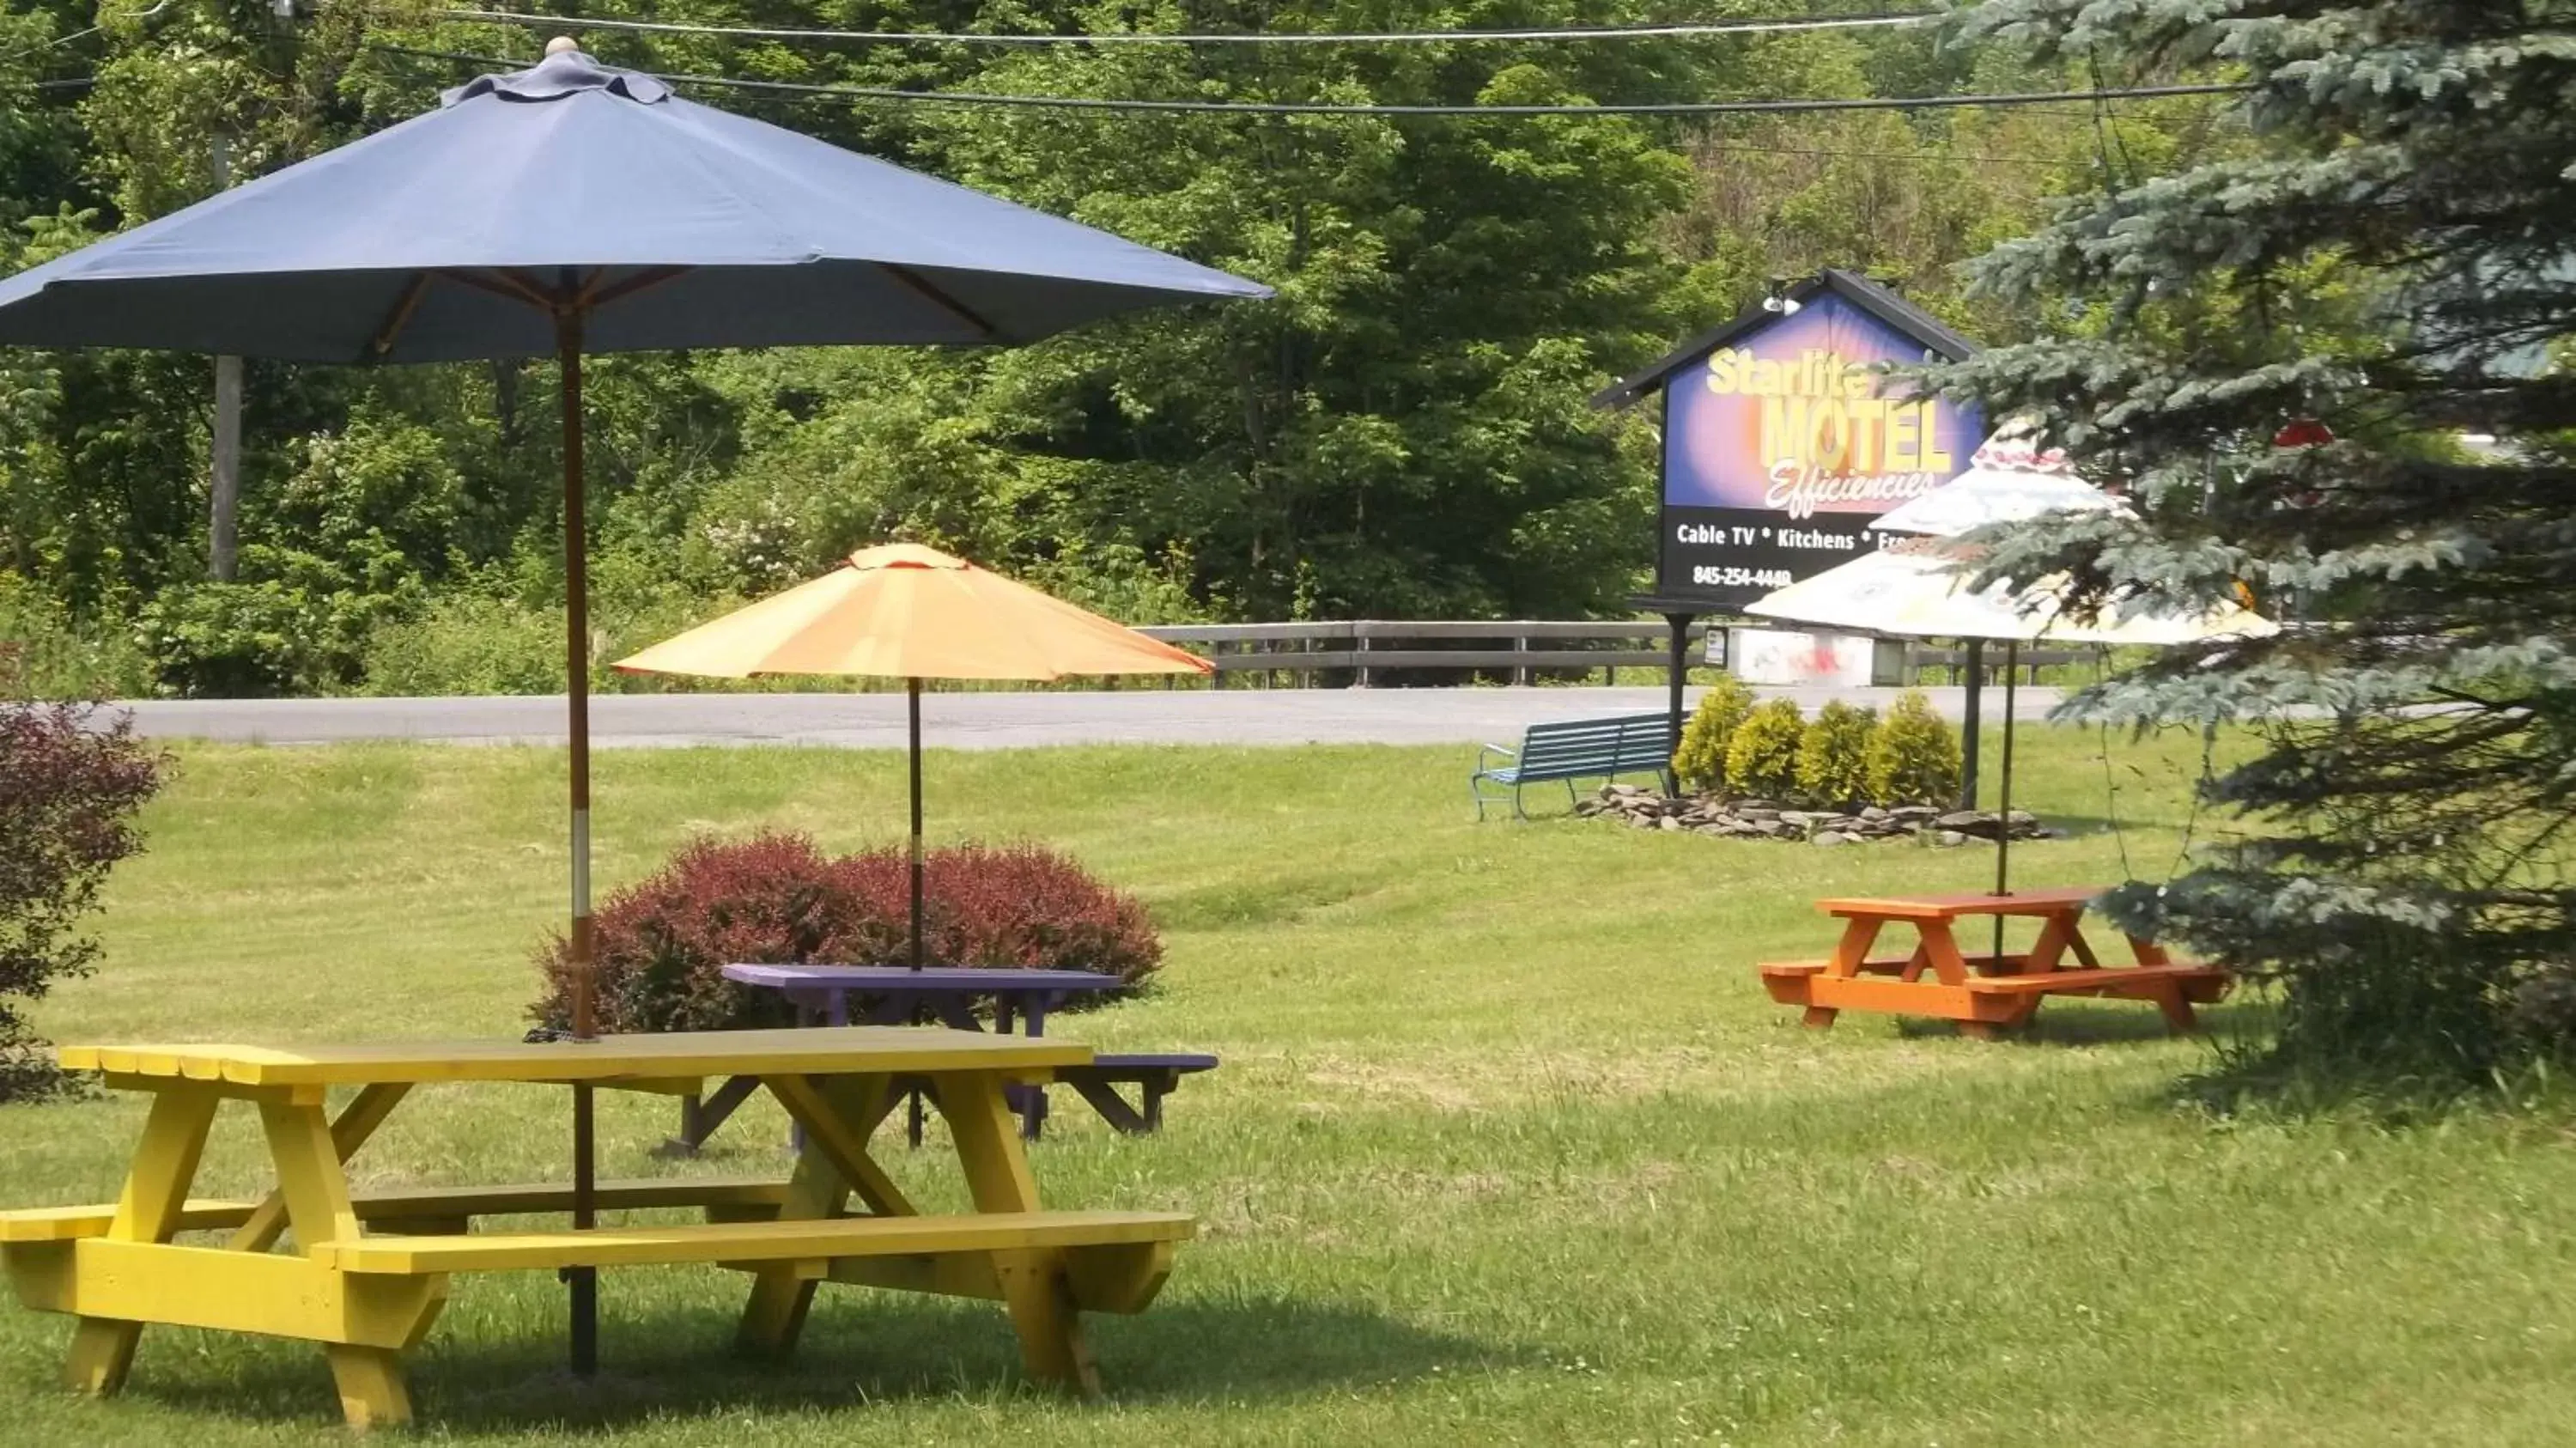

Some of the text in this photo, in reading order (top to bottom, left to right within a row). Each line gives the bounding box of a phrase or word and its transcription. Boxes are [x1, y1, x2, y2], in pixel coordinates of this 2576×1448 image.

[1706, 346, 1868, 398] Starlite
[1760, 395, 1952, 472] MOTEL
[1765, 458, 1935, 520] Efficiencies
[1677, 524, 1727, 545] Cable
[1732, 526, 1756, 545] TV
[1777, 529, 1856, 550] Kitchens
